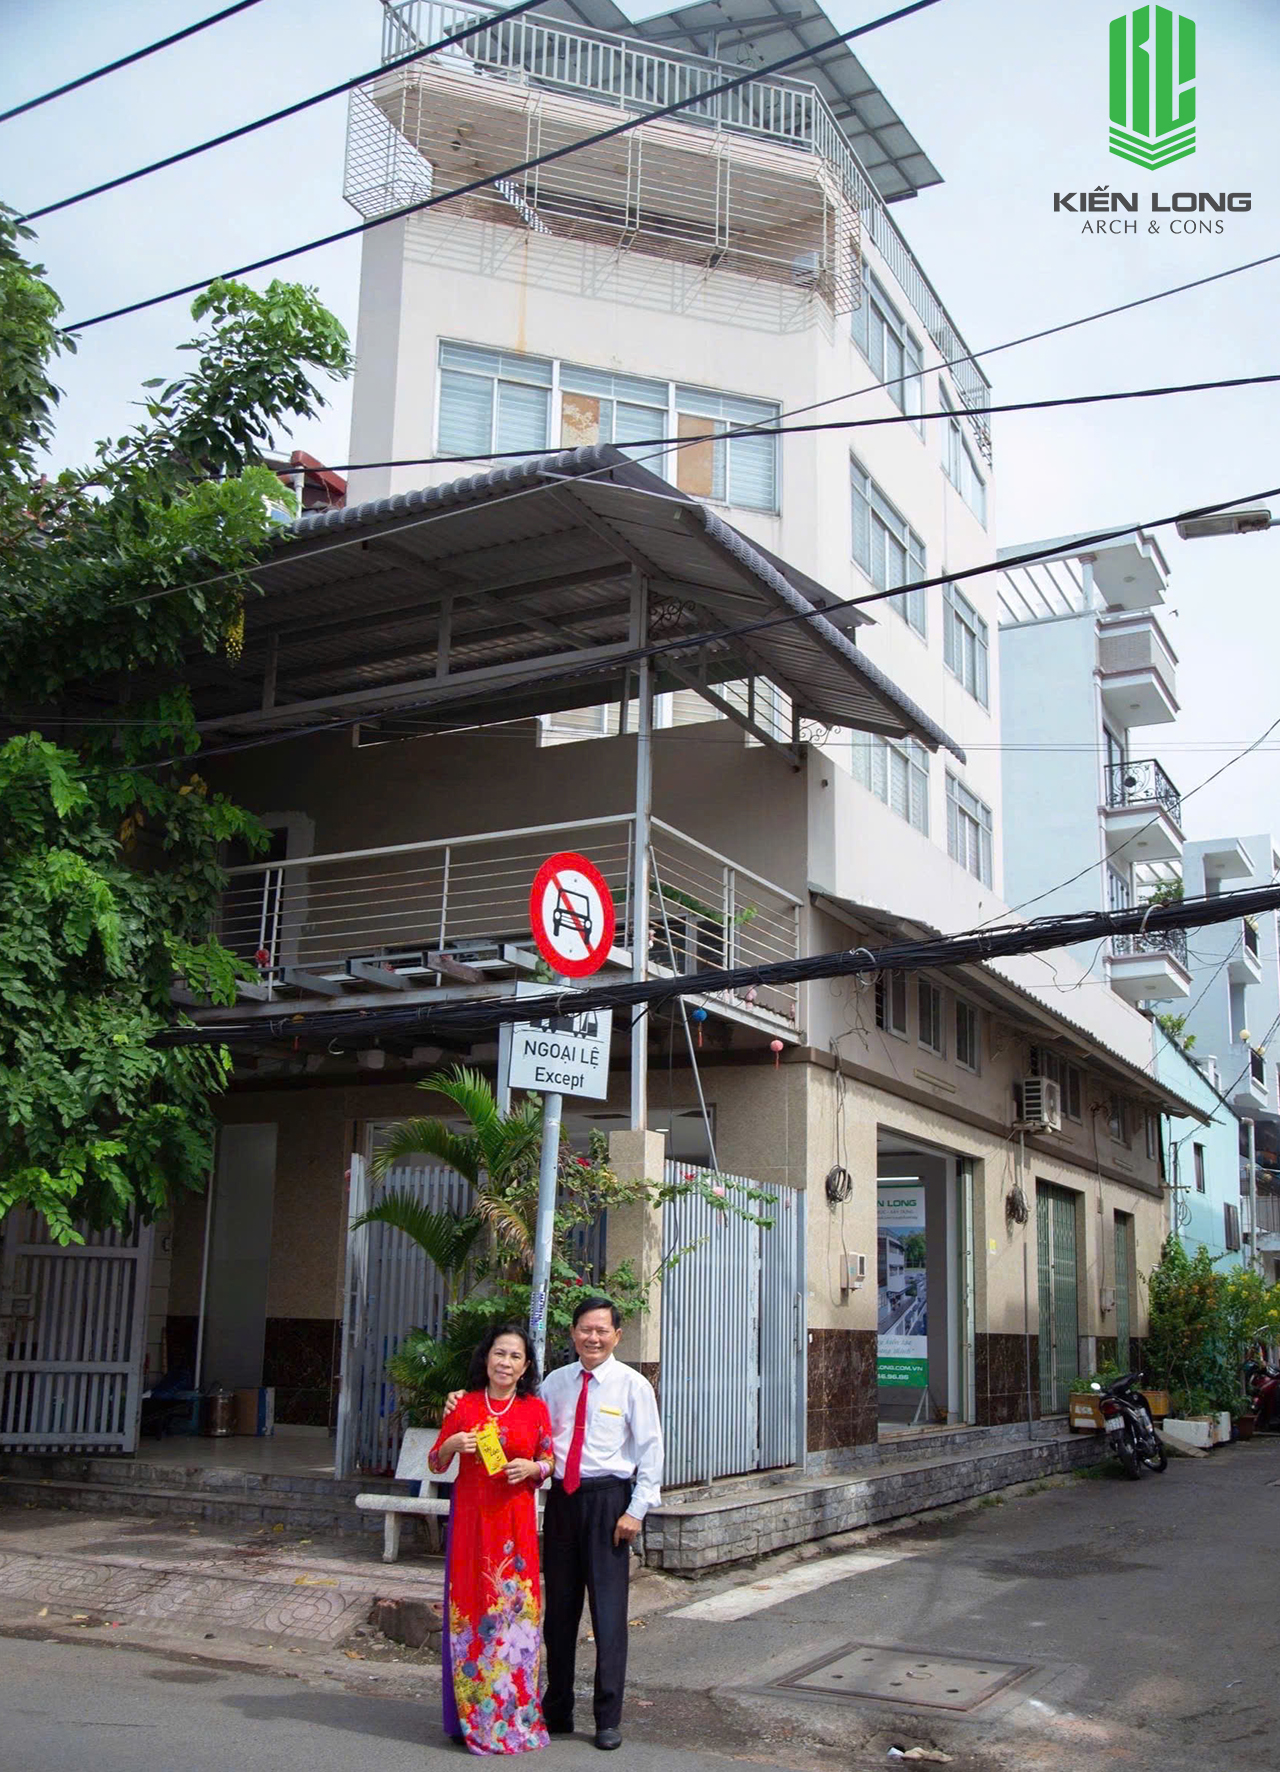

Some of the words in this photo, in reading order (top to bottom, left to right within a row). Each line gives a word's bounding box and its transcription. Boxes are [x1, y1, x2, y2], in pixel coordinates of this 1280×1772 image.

[524, 1040, 576, 1064] NGOẠI
[580, 1046, 600, 1069] LỆ
[535, 1066, 584, 1090] Except
[887, 1199, 917, 1207] LONG
